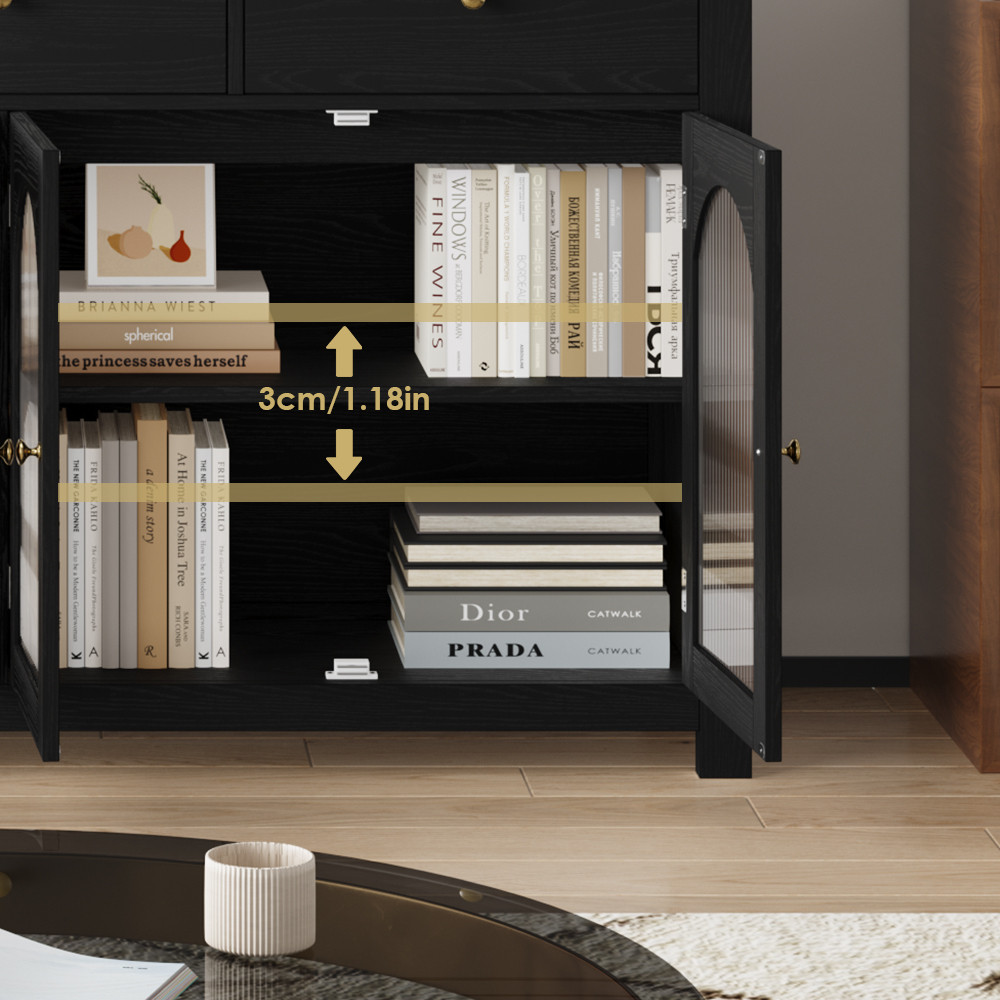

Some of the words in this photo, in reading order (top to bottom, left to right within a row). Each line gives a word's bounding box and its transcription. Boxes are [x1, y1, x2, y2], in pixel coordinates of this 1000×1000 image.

[432, 197, 443, 254] FINE
[451, 176, 467, 261] WINDOWS
[568, 197, 580, 270] БОЖЕСТВЕННАЯ
[550, 230, 560, 272] Уличный
[78, 301, 157, 312] BRIANNA
[165, 301, 216, 312] WIEST
[432, 265, 443, 349] WINES
[124, 327, 174, 344] spherical
[550, 336, 560, 355] Боб
[568, 322, 583, 349] РАЙ
[668, 335, 679, 360] арка
[82, 355, 150, 370] princess
[150, 358, 192, 367] saves
[193, 355, 248, 368] herself
[177, 452, 188, 466] At
[90, 461, 98, 492] FRIDA
[217, 461, 225, 492] FRIDA
[90, 495, 98, 532] KAHLO
[177, 506, 188, 518] in
[217, 495, 225, 532] KAHLO
[143, 516, 155, 544] story
[176, 520, 188, 558] Joshua
[177, 562, 188, 587] Tree
[460, 603, 529, 622] Dior
[588, 610, 643, 619] CATWALK
[448, 643, 544, 658] PRADA
[588, 647, 642, 655] CATWALK
